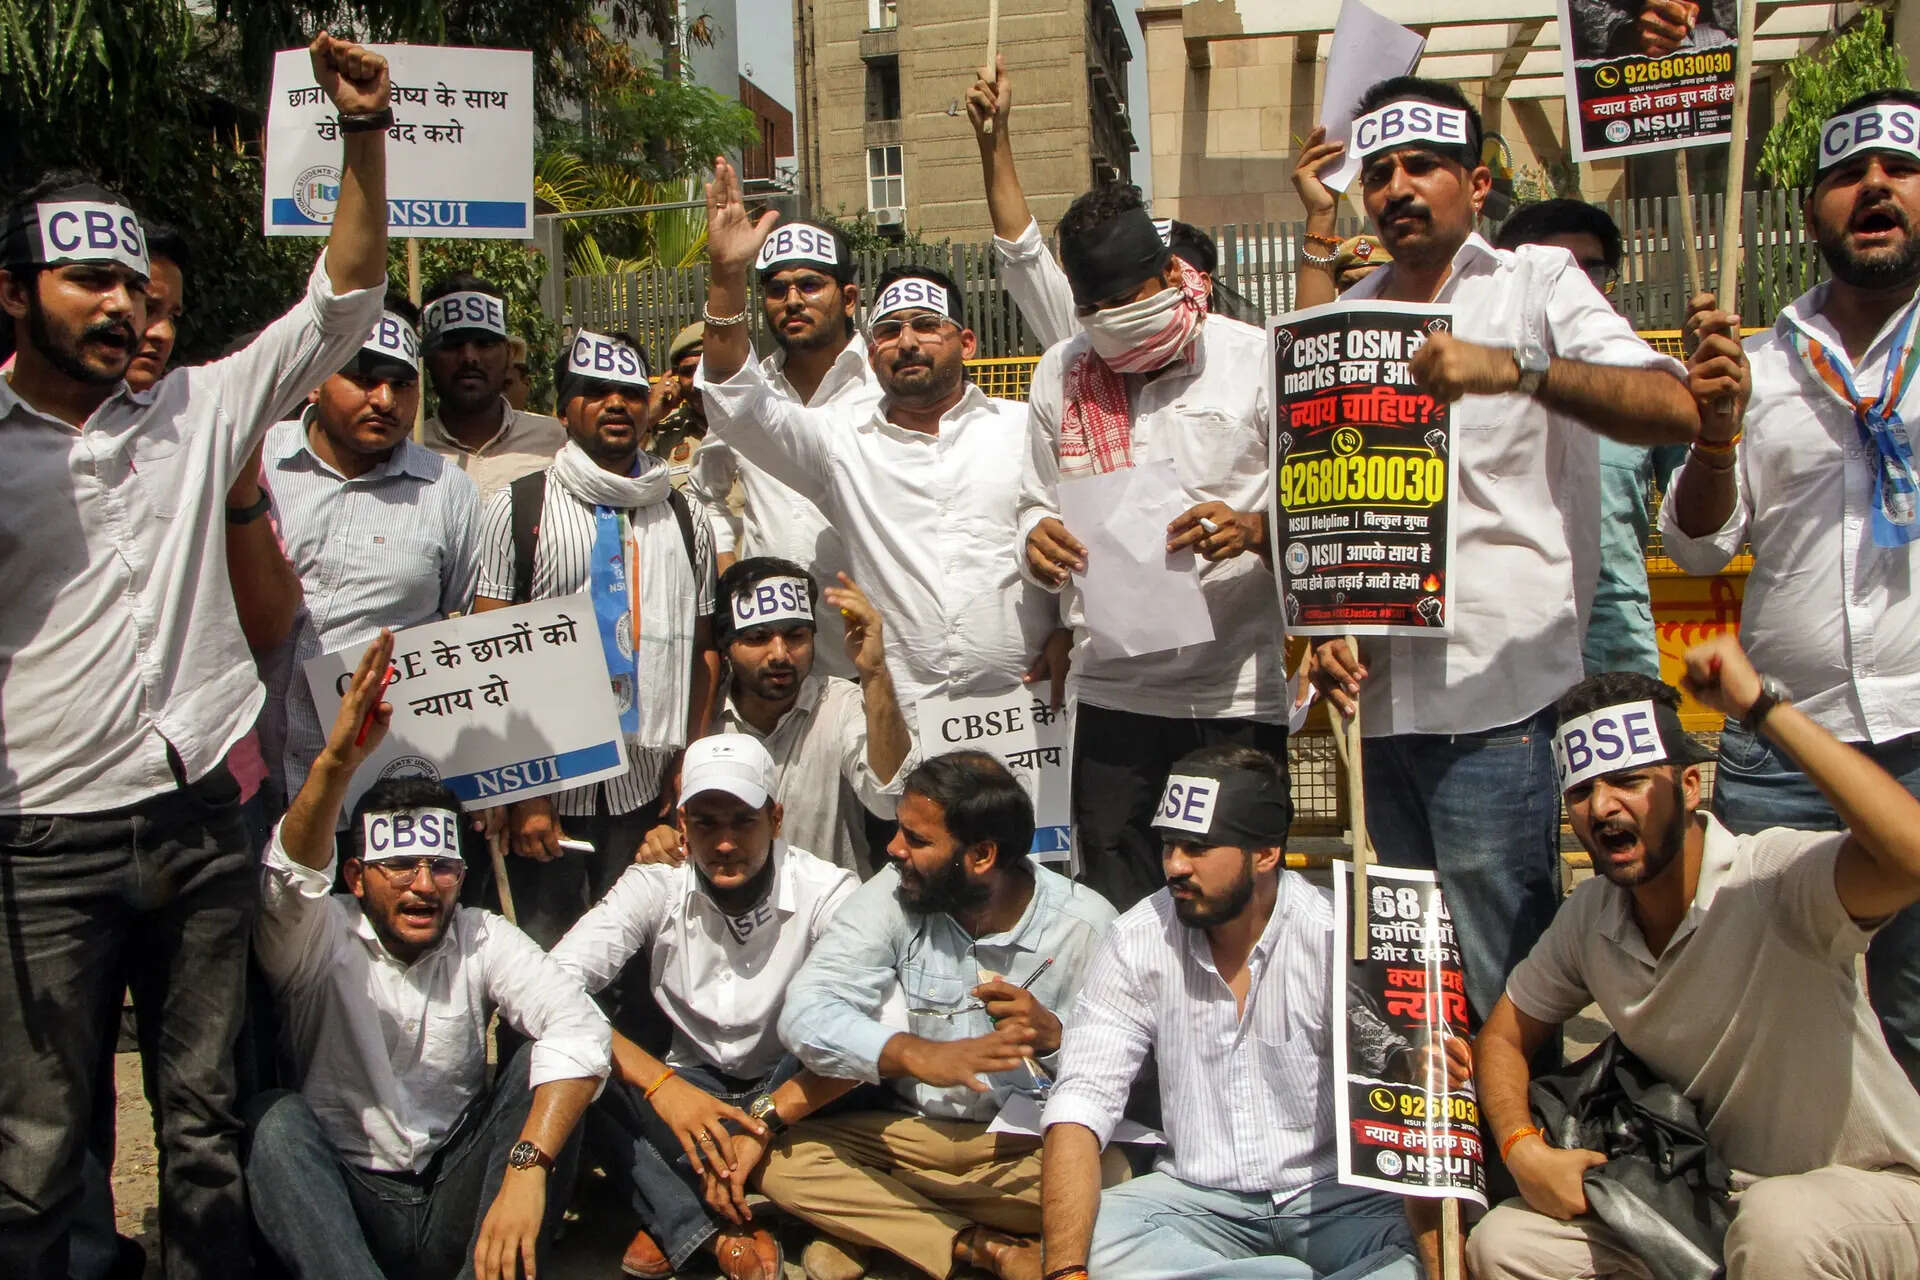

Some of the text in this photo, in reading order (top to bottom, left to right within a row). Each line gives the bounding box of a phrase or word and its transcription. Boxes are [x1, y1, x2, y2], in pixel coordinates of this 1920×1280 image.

[1624, 53, 1731, 84] 9268030030
[434, 82, 456, 108] के
[462, 88, 508, 109] साथ
[1593, 101, 1625, 115] न्याय
[1629, 94, 1651, 112] होने
[1654, 93, 1677, 108] तक
[1680, 91, 1697, 108] चुप
[1699, 85, 1718, 102] नहीं
[388, 119, 417, 144] बंद
[423, 118, 464, 144] करो
[1357, 107, 1459, 150] CBSE
[1634, 112, 1690, 132] NSUI
[1824, 111, 1920, 156] CBS
[388, 201, 468, 226] NSUI
[49, 211, 141, 256] CBS
[762, 229, 833, 262] CBSE
[429, 297, 501, 331] CBSE
[367, 317, 421, 358] BS
[1293, 331, 1341, 368] CBSE
[1347, 330, 1402, 359] OSM
[573, 337, 642, 378] CBS
[1284, 364, 1335, 395] marks
[1339, 361, 1379, 384] कम
[1290, 387, 1435, 428] न्याय चाहिए?
[1280, 456, 1444, 507] 9268030030
[1288, 515, 1310, 532] NSUI
[1312, 513, 1349, 531] Helpline
[1363, 512, 1401, 530] बिल्कुल
[1312, 543, 1342, 566] NSUI
[1346, 541, 1385, 561] आपके
[1388, 546, 1418, 562] साथ
[1291, 572, 1420, 591] न्याय होने तक लड़ाई जारी रहेगी
[736, 582, 809, 620] CBSE
[432, 640, 461, 668] के
[467, 622, 533, 662] छात्रों
[539, 614, 577, 646] को
[409, 674, 509, 717] न्याय दो
[941, 707, 1024, 743] CBSE
[1029, 698, 1056, 726] के
[1004, 746, 1062, 770] न्याय
[474, 755, 561, 798] NSUI
[1157, 783, 1210, 824] SE
[370, 815, 456, 851] CBSE
[1371, 943, 1408, 962] और
[1404, 1119, 1421, 1127] NSUI
[1364, 1126, 1399, 1144] न्याय
[1402, 1129, 1427, 1149] होने
[1431, 1135, 1457, 1149] तक
[1459, 1137, 1477, 1156] चुप
[1406, 1154, 1471, 1176] NSUI
